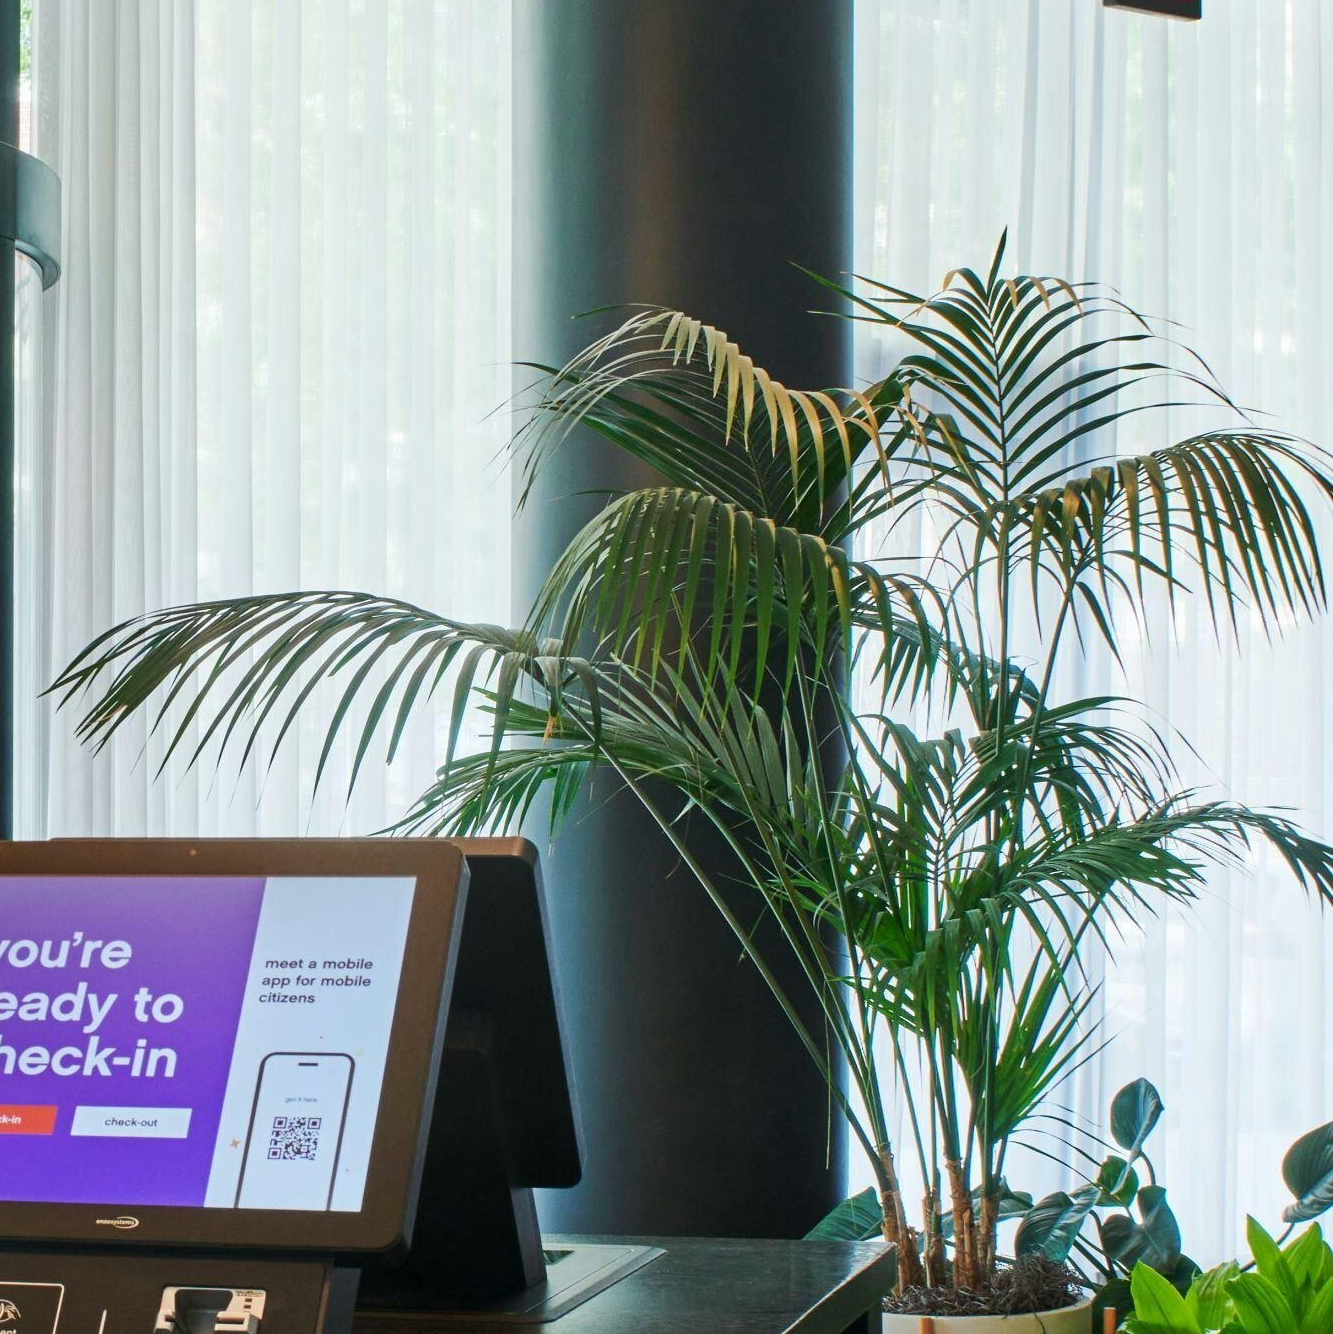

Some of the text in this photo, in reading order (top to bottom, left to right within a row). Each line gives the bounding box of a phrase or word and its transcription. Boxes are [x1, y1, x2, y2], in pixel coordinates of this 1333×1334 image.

[265, 958, 373, 970] meet a mobile
[261, 975, 371, 989] app for mobile
[258, 992, 316, 1004] citizens
[134, 987, 184, 1023] to
[104, 1117, 158, 1128] check-out
